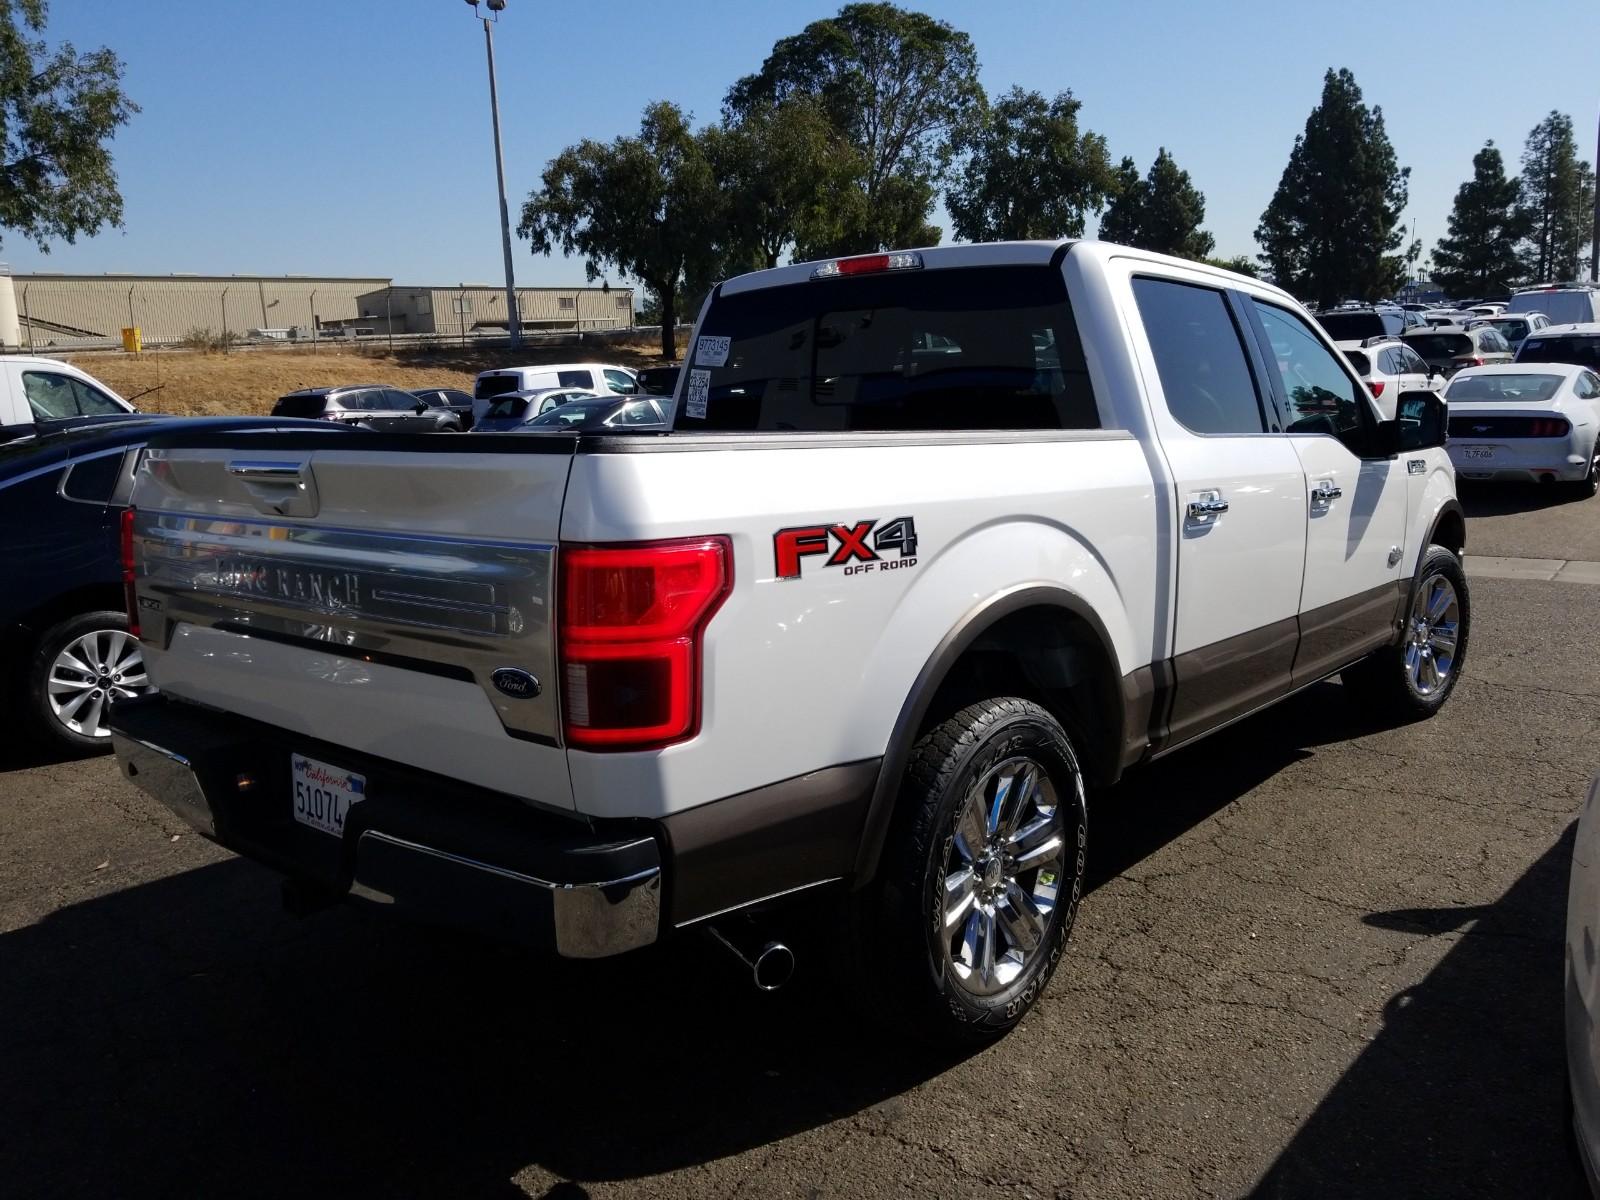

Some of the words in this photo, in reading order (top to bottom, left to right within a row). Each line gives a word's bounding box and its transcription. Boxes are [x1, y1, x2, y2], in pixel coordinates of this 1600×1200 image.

[772, 515, 918, 580] FX4
[843, 563, 875, 576] OFF
[879, 558, 918, 571] ROAD
[276, 568, 361, 608] RANCH
[305, 763, 352, 792] California
[296, 781, 352, 828] 51074
